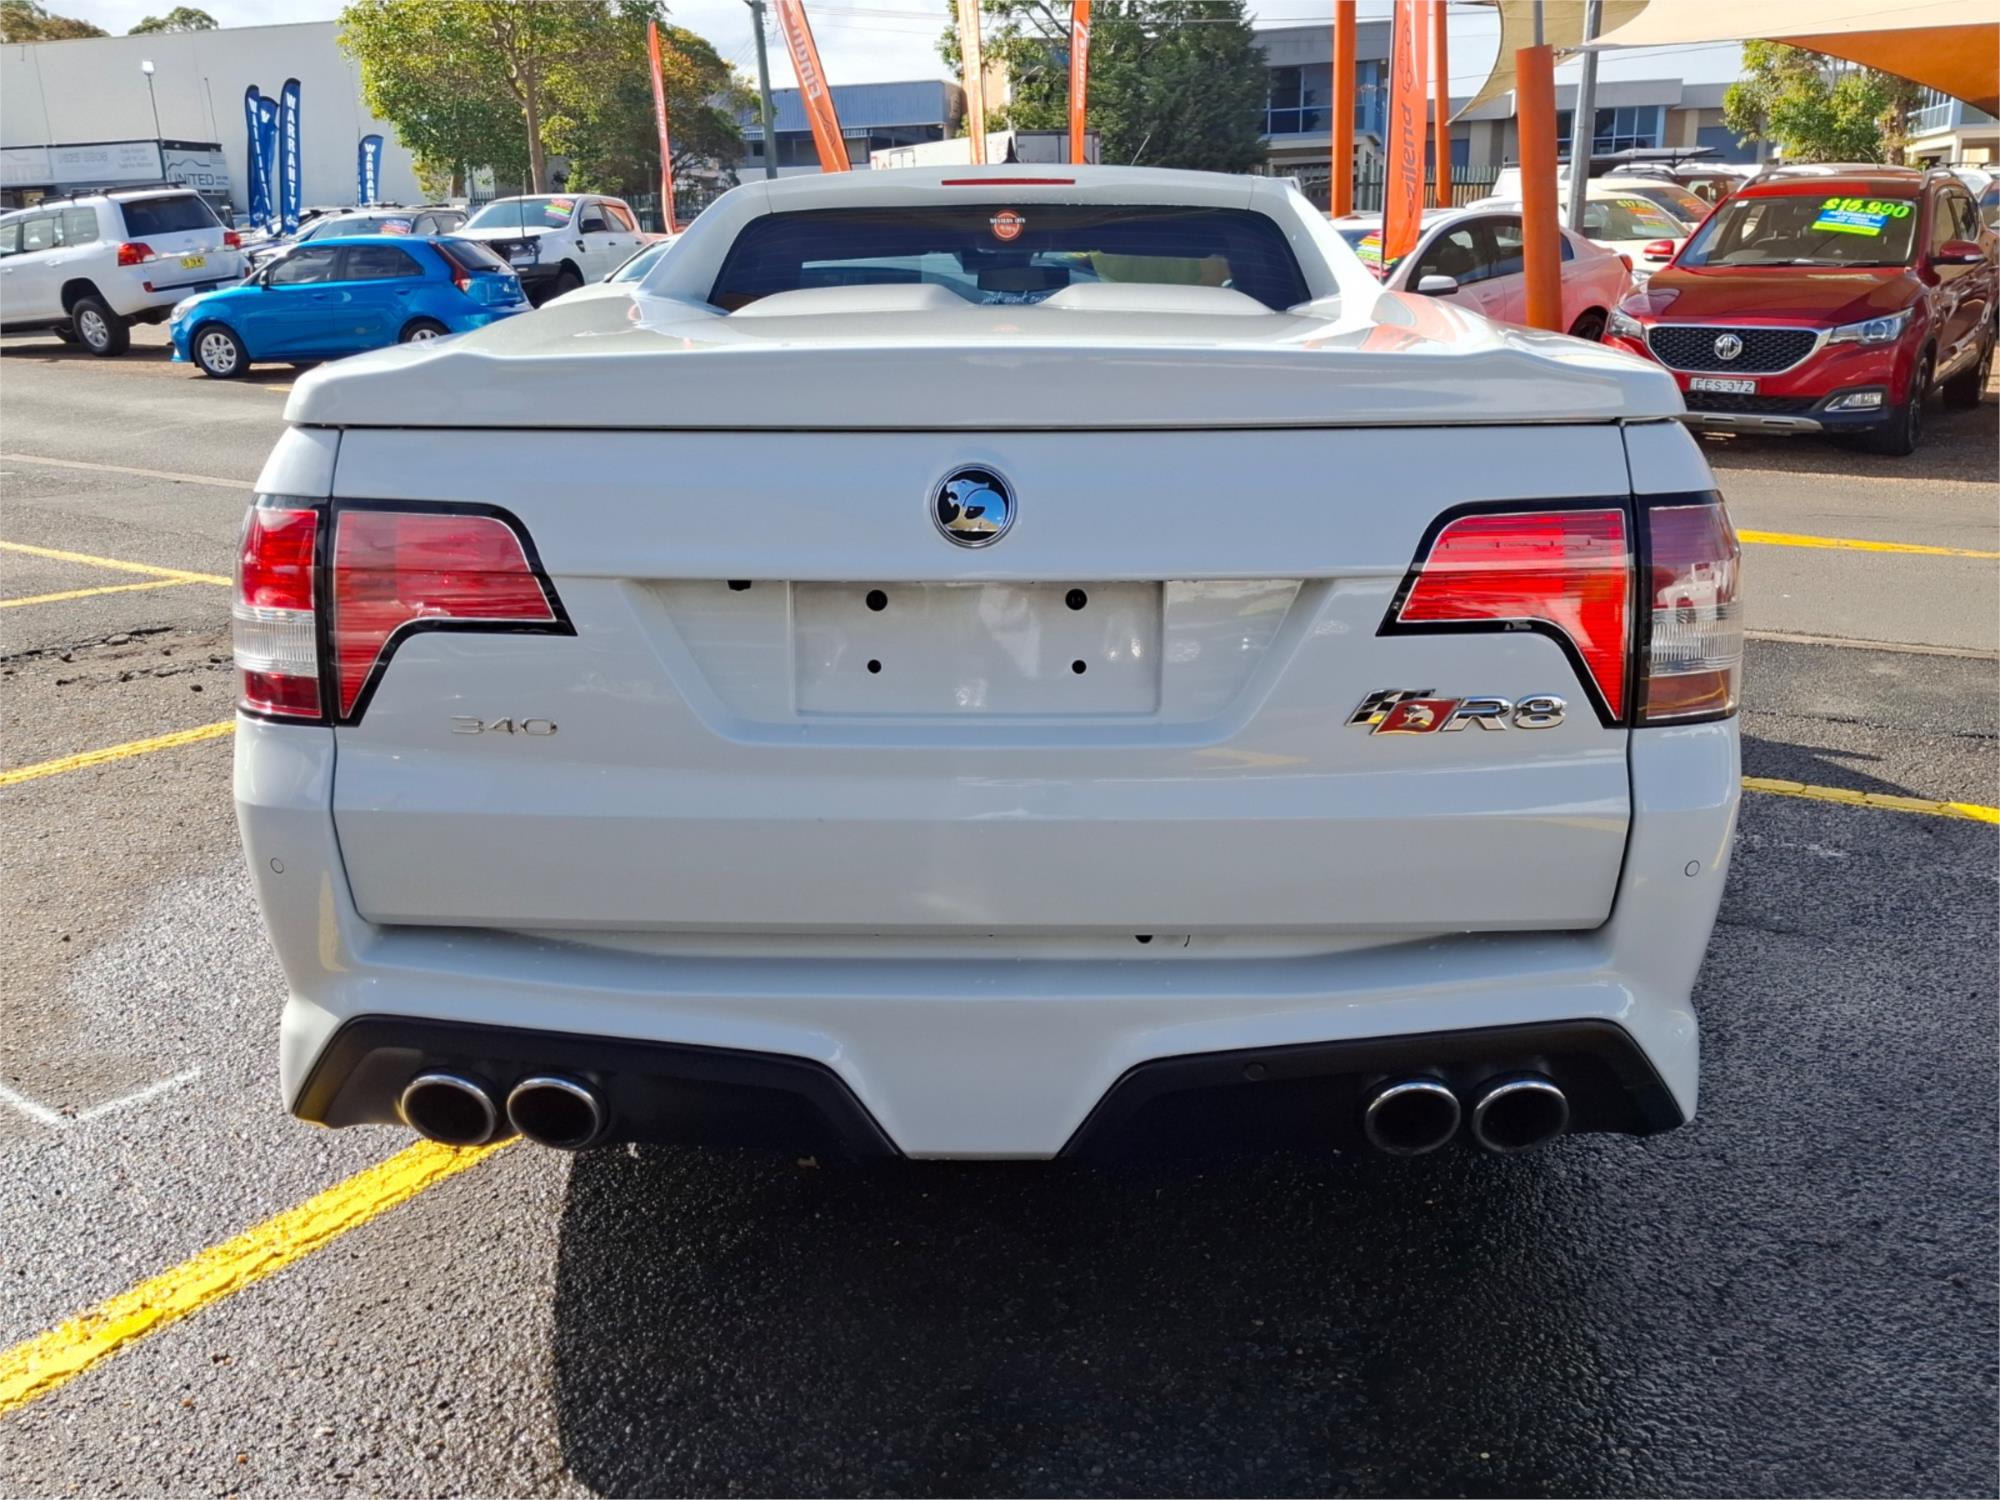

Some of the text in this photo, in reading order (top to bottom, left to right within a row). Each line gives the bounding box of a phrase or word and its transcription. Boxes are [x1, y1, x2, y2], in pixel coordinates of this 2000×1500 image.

[286, 91, 297, 210] WARRANTY
[449, 715, 558, 736] 340
[1441, 693, 1567, 732] R8
